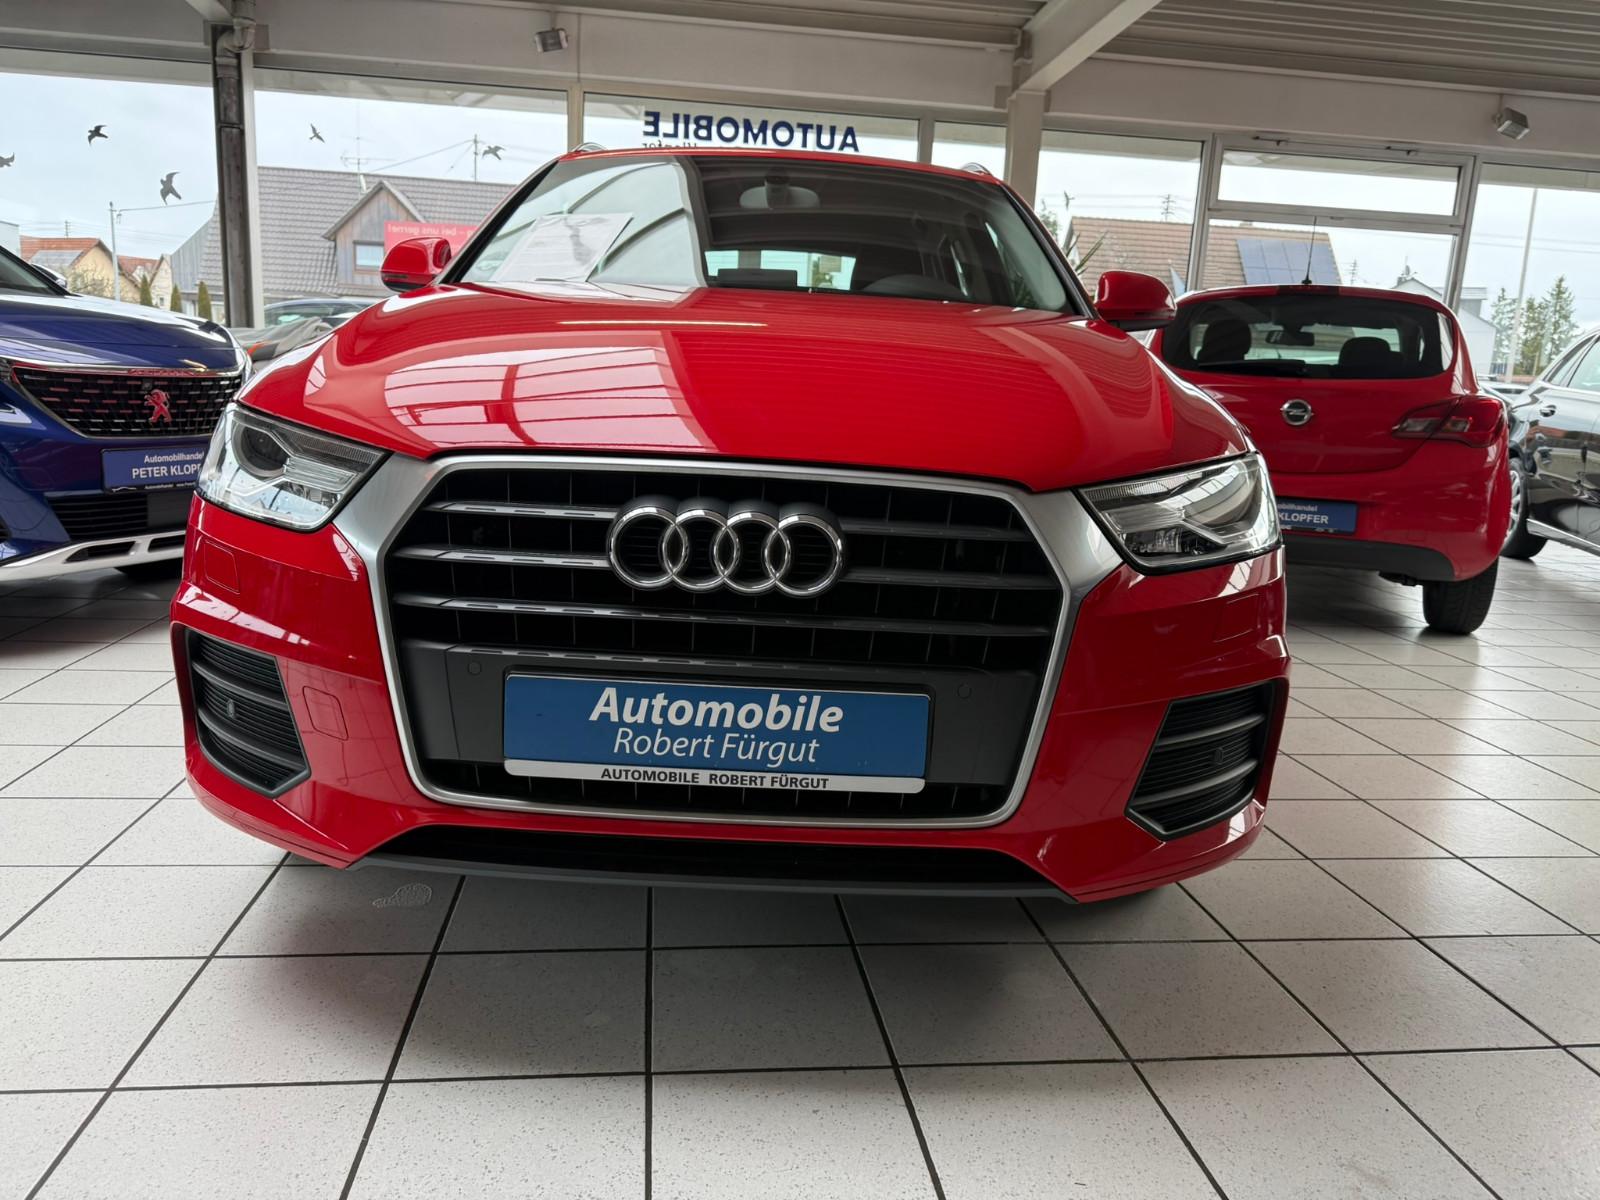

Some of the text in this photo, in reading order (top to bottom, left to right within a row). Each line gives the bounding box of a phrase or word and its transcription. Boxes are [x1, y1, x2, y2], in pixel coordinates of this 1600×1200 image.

[132, 467, 168, 479] PETER
[1278, 512, 1328, 524] KLOPFER
[589, 687, 844, 733] Automobile
[613, 727, 820, 768] Robert Fürgut
[601, 768, 829, 789] AUTOMOBILE ROBERT FÜRGUT
